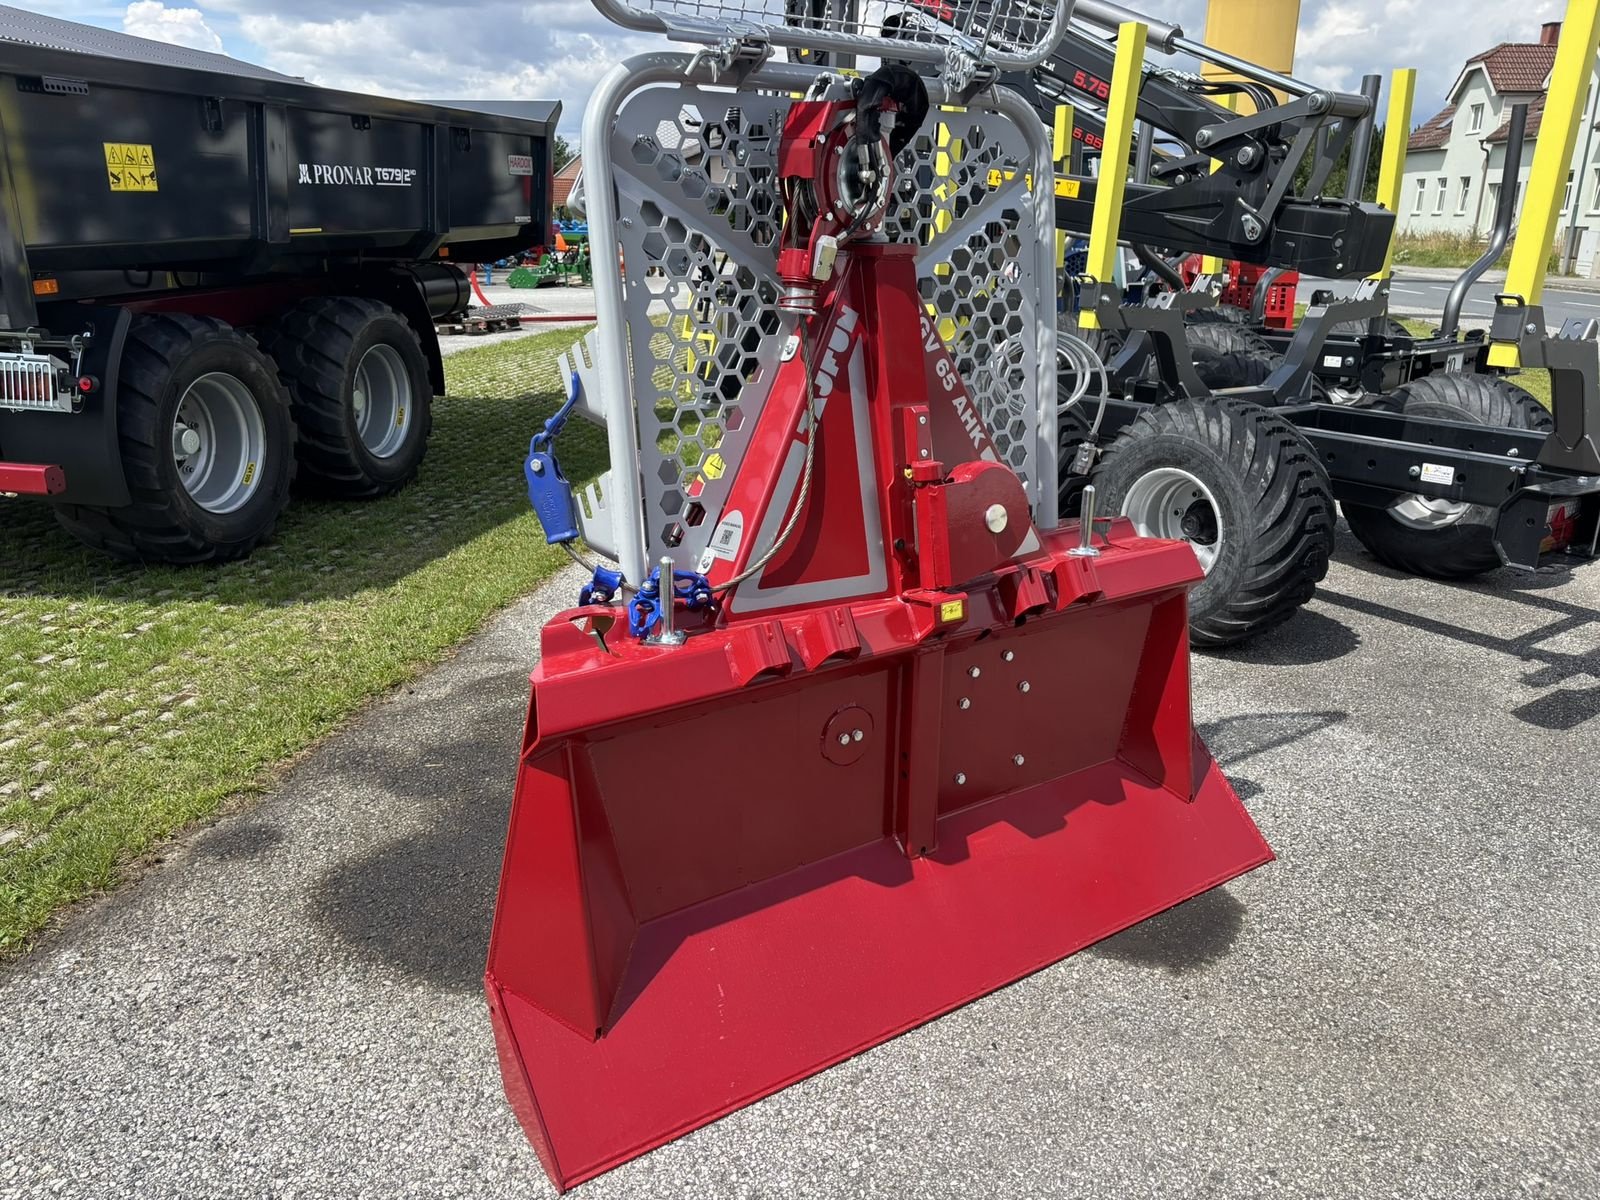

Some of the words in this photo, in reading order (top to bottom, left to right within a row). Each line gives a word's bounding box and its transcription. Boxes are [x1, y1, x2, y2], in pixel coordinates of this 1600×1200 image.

[1072, 69, 1110, 99] 5.75
[1073, 127, 1104, 149] 5.85
[313, 164, 374, 186] PRONAR
[919, 304, 940, 353] GV
[935, 358, 957, 391] 65
[951, 395, 986, 449] AHK
